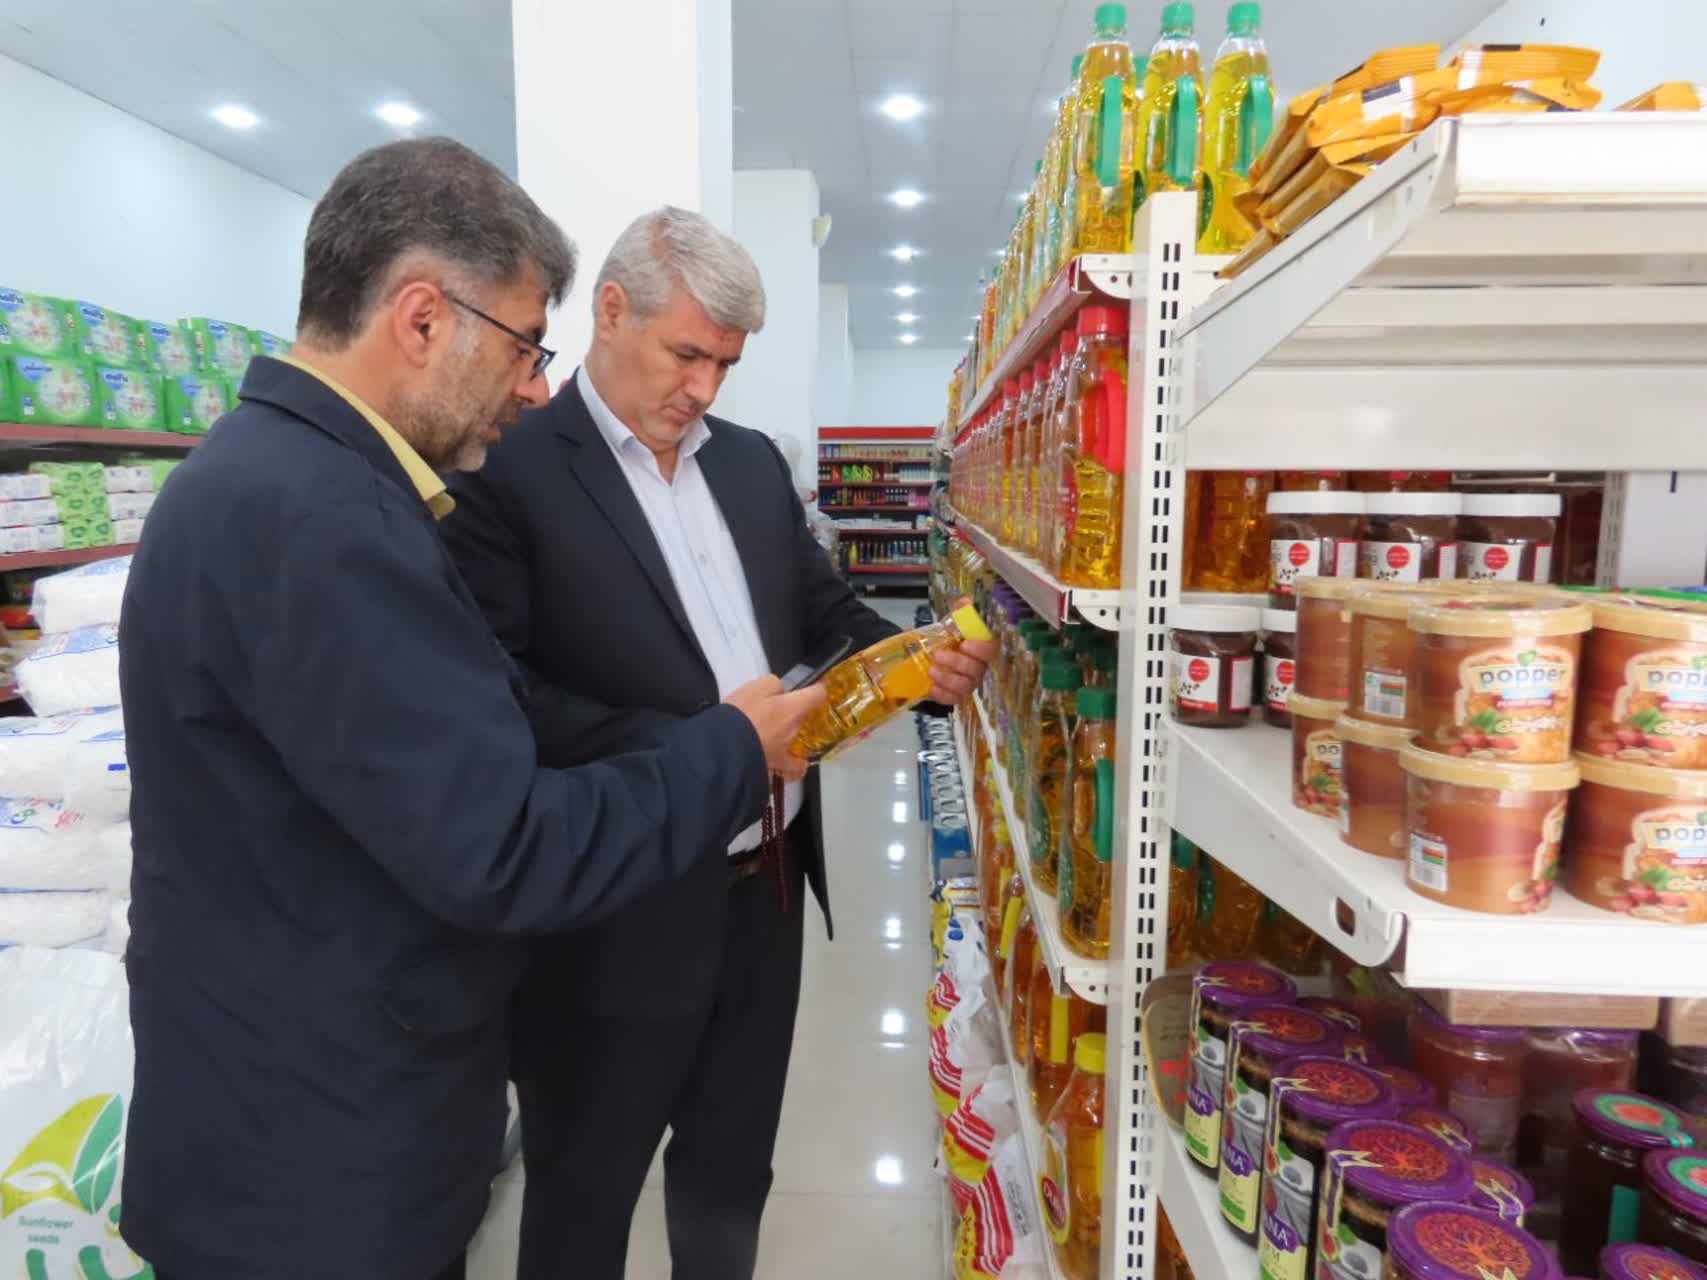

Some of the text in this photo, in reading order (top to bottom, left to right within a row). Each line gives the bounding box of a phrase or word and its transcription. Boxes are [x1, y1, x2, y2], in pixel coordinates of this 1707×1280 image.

[1479, 668, 1567, 688] popper
[1648, 671, 1707, 690] pop
[18, 1216, 74, 1229] Sunflower
